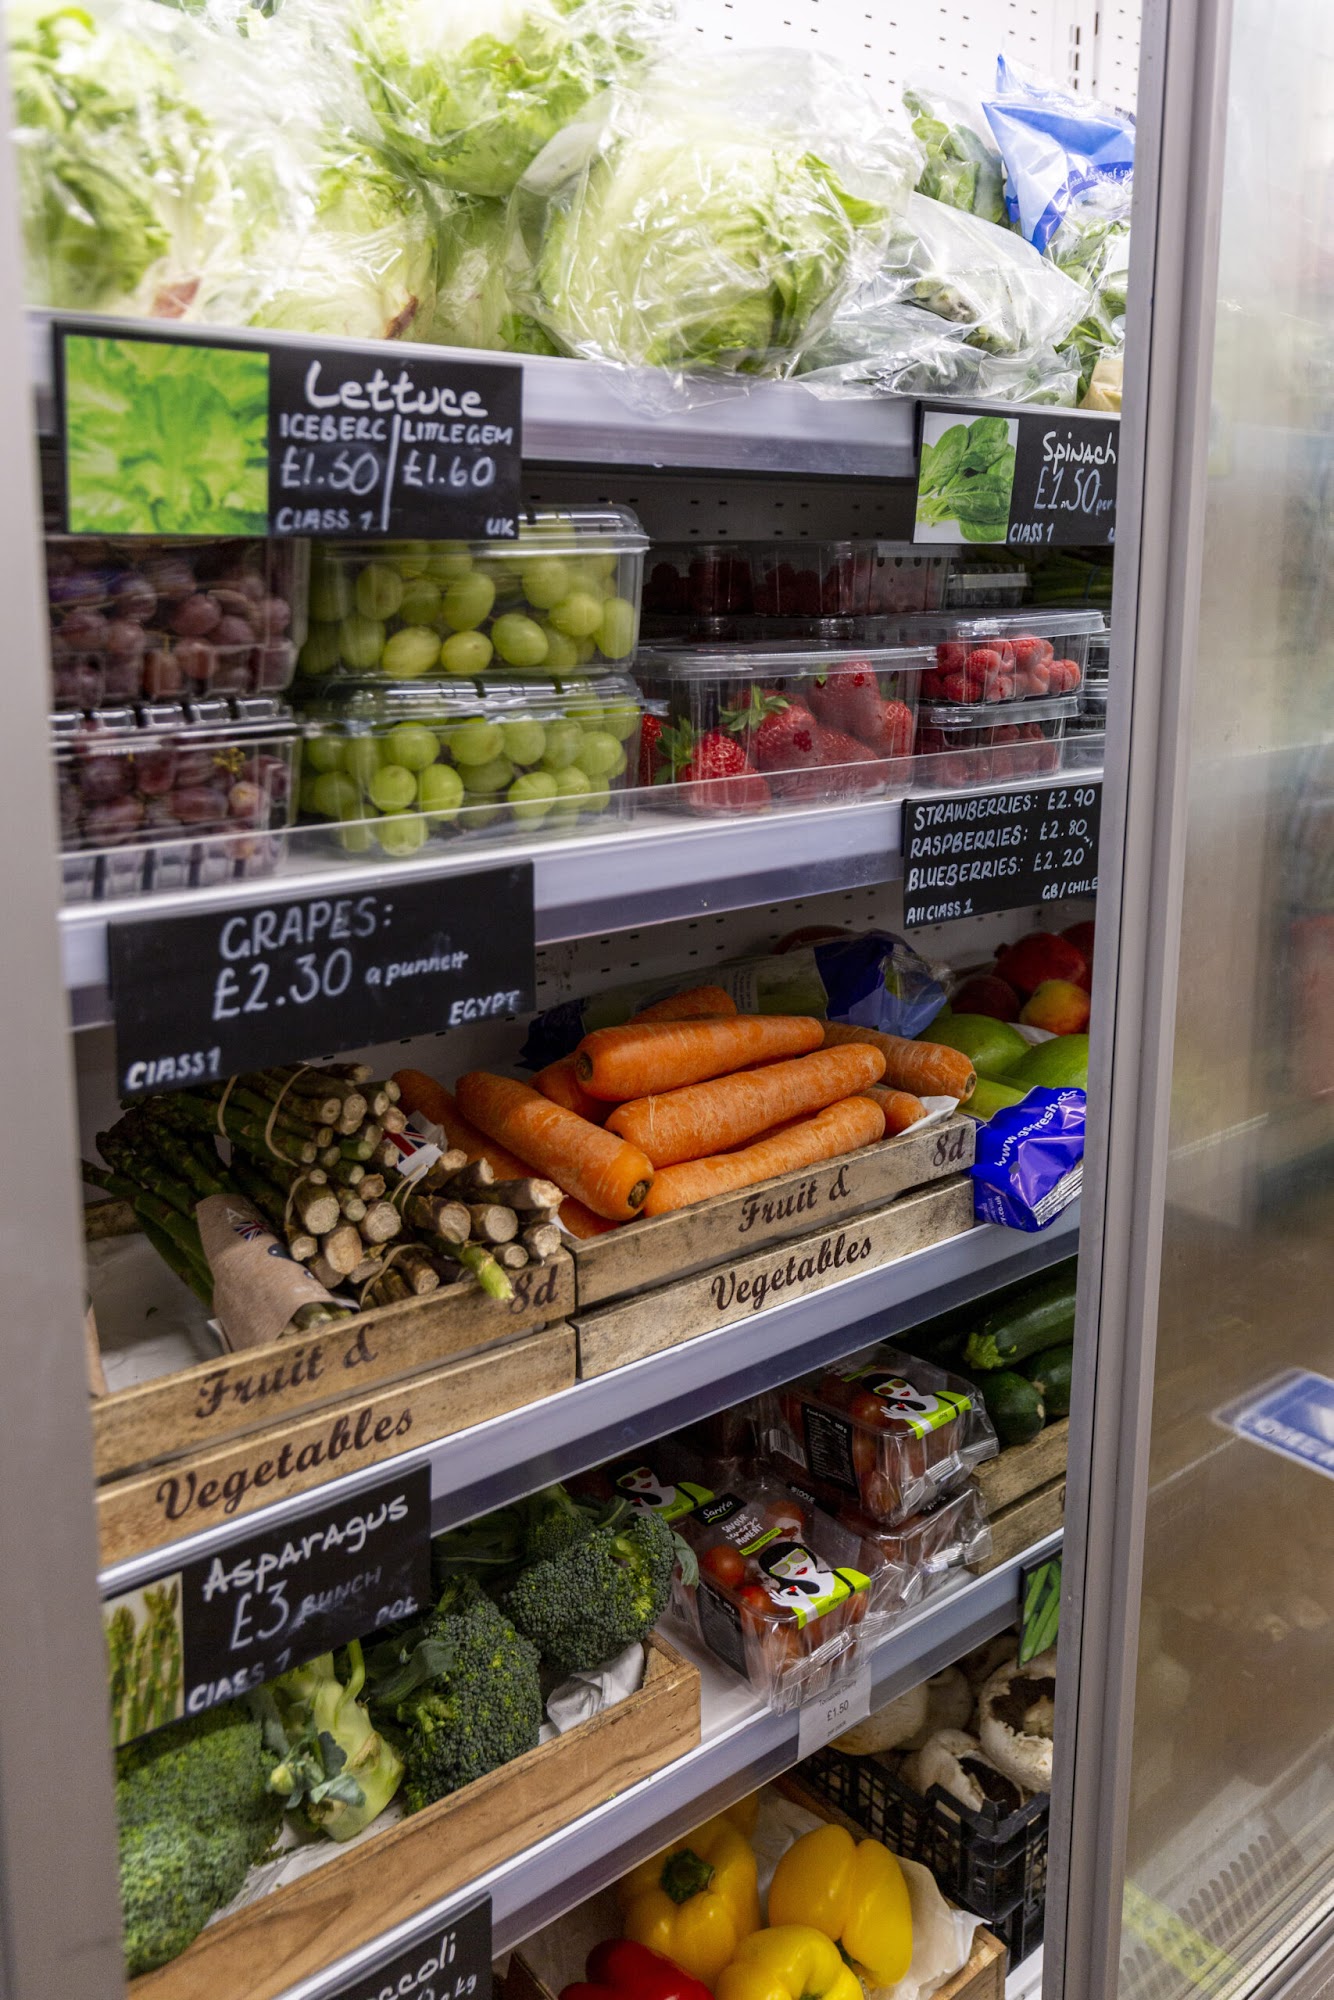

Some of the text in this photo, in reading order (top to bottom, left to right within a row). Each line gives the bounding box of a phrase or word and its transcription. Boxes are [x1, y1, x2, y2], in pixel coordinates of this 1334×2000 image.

[305, 360, 488, 418] Lettuce
[281, 445, 380, 496] £1.50
[402, 448, 496, 487] £1.60
[486, 517, 516, 537] UK
[913, 788, 1096, 831] STRAWBERRIES: £2.90
[910, 819, 1088, 859] RASPBERRIES: £2.80
[908, 848, 1085, 892] BLUEBERRIES: £2.20
[219, 896, 394, 962] GRAPES:
[963, 898, 974, 914] 1
[211, 947, 353, 1021] £2.30
[365, 966, 382, 985] a
[448, 989, 520, 1026] EGYPT
[207, 1046, 222, 1073] 1
[931, 1128, 967, 1168] 8d
[738, 1179, 818, 1232] Fruit
[711, 1233, 872, 1312] Vegetables
[195, 1344, 325, 1419] Fruit
[154, 1407, 414, 1521] Vegetables
[230, 1579, 290, 1651] £3
[827, 1699, 849, 1721] £1.50
[372, 1931, 457, 2000] ccoli
